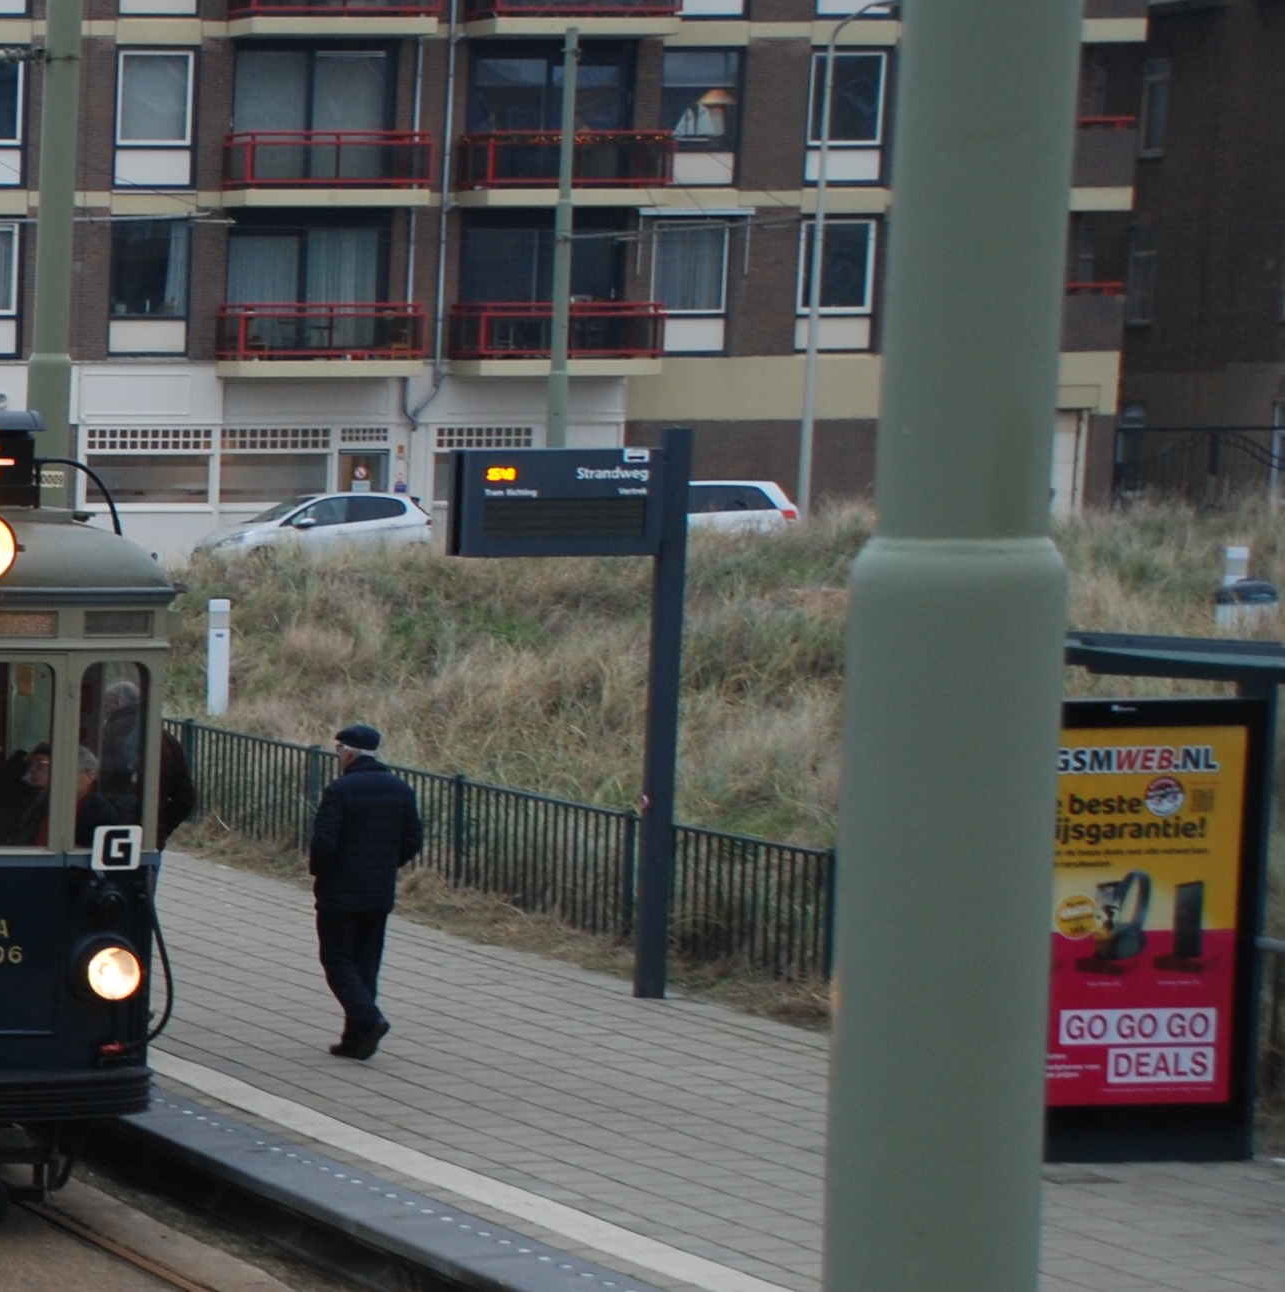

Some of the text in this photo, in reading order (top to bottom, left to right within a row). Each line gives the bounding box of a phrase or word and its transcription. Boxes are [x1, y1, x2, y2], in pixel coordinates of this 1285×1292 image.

[576, 467, 649, 482] Strandweg
[1058, 748, 1218, 771] GSMWEB.NL
[1068, 794, 1142, 815] beste
[102, 829, 134, 866] G
[1065, 1013, 1209, 1040] GO GO GO
[1113, 1052, 1208, 1078] DEALS
